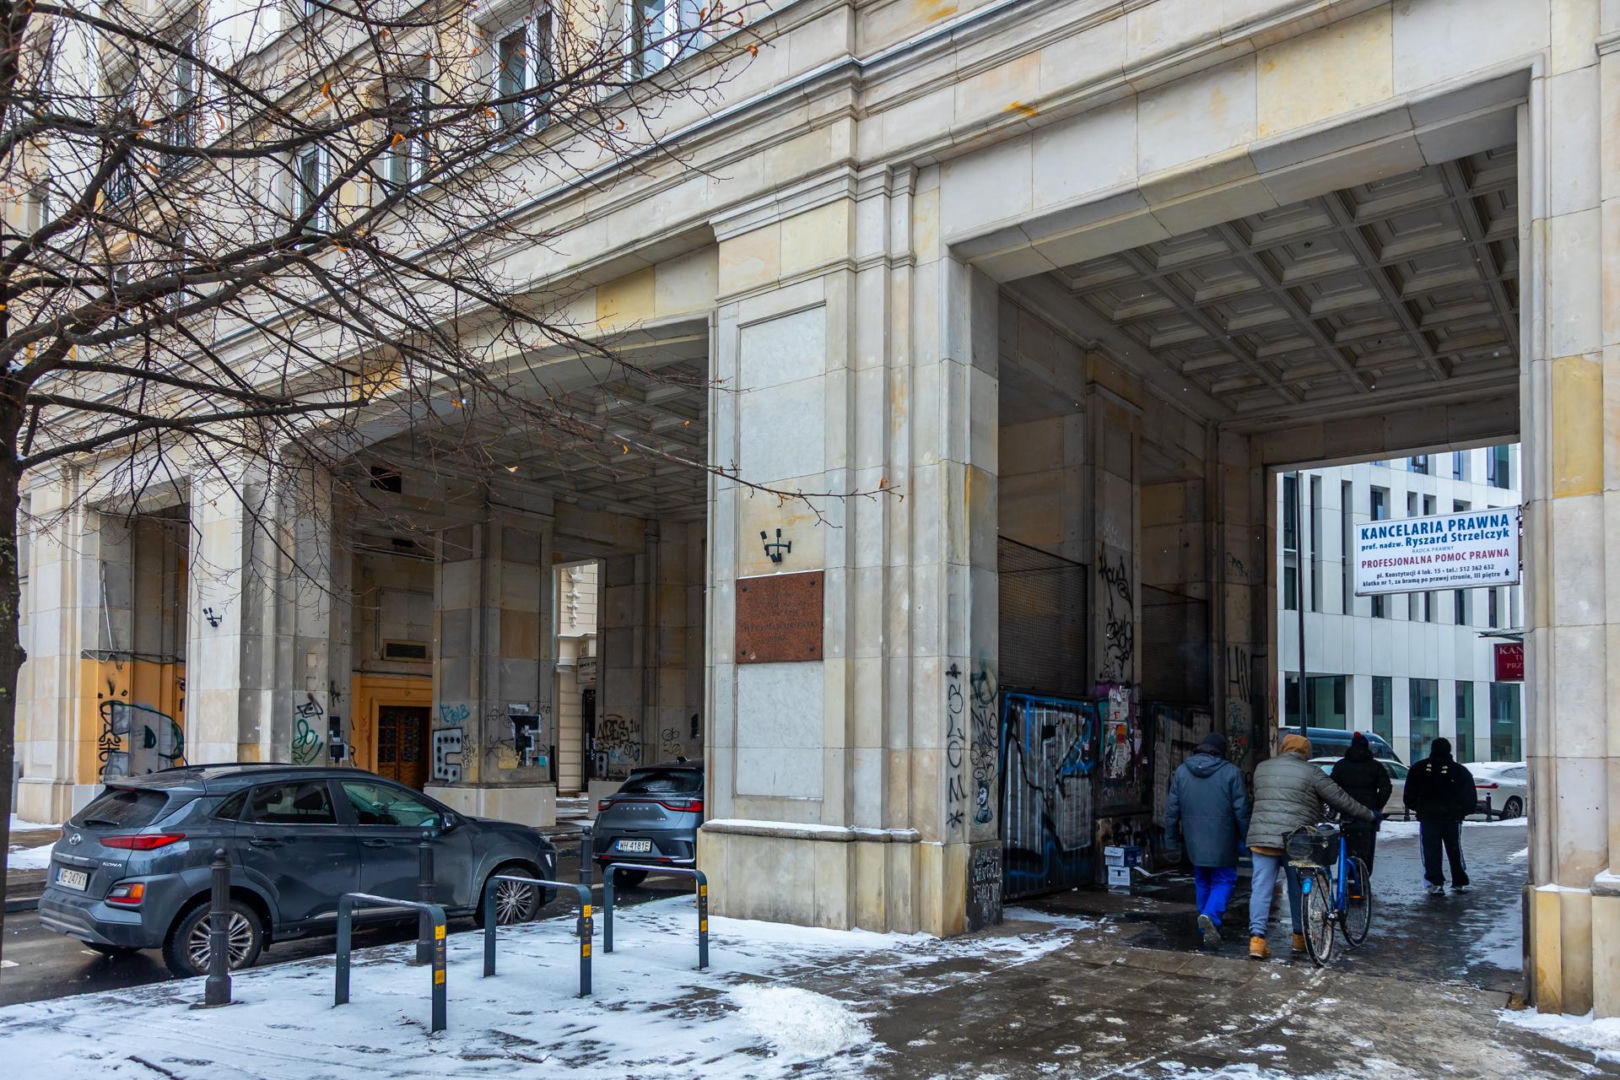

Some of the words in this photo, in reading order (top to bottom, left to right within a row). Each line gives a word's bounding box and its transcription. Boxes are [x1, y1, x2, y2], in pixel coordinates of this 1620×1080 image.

[1362, 521, 1443, 540] KANCELARIA
[1448, 514, 1509, 532] PRAWNA
[1406, 534, 1447, 548] Ryszard
[1451, 528, 1509, 542] Strzelczyk
[1362, 555, 1432, 568] PROFESJONALNA
[1435, 551, 1466, 562] POMOC
[1470, 548, 1509, 560] PRAWNA
